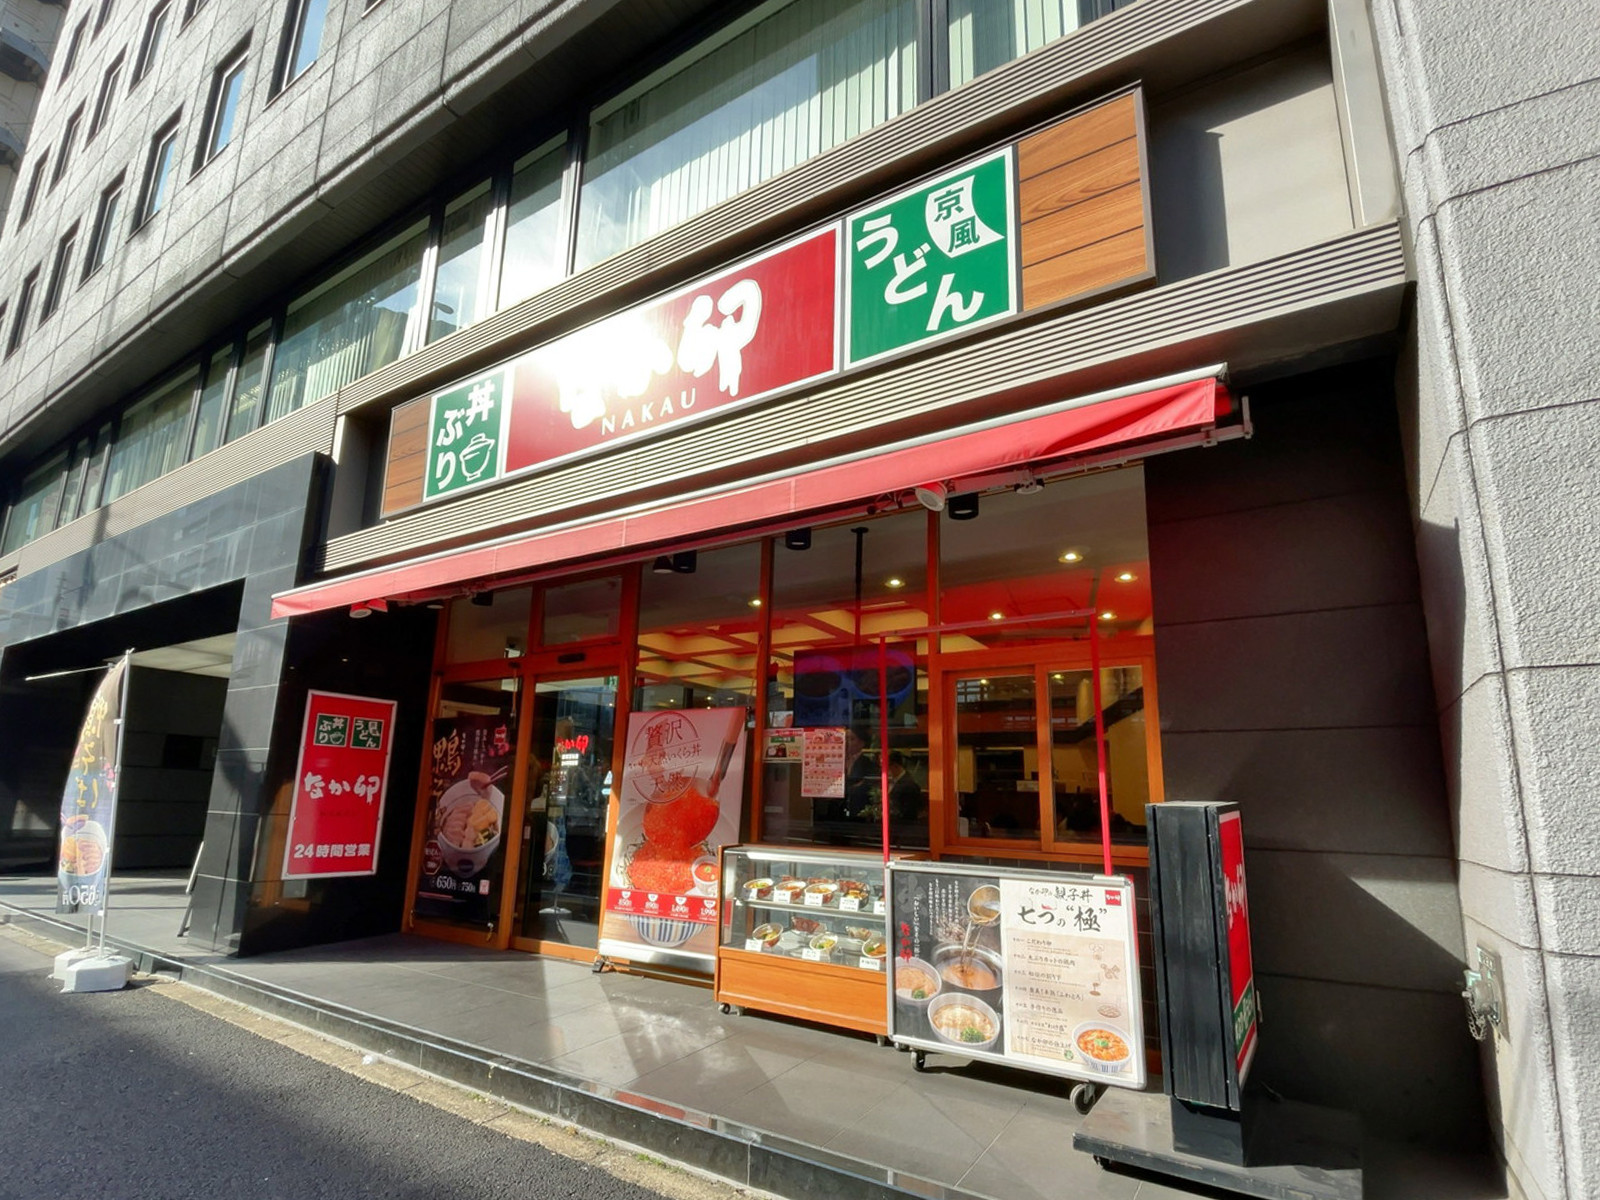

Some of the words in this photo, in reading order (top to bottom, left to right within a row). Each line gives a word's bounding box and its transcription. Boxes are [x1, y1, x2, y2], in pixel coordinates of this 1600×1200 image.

[933, 187, 980, 252] 京風
[856, 213, 985, 331] うどん
[602, 388, 696, 435] NAKAU
[304, 771, 380, 805] なか卵
[294, 843, 371, 858] 24時間営業
